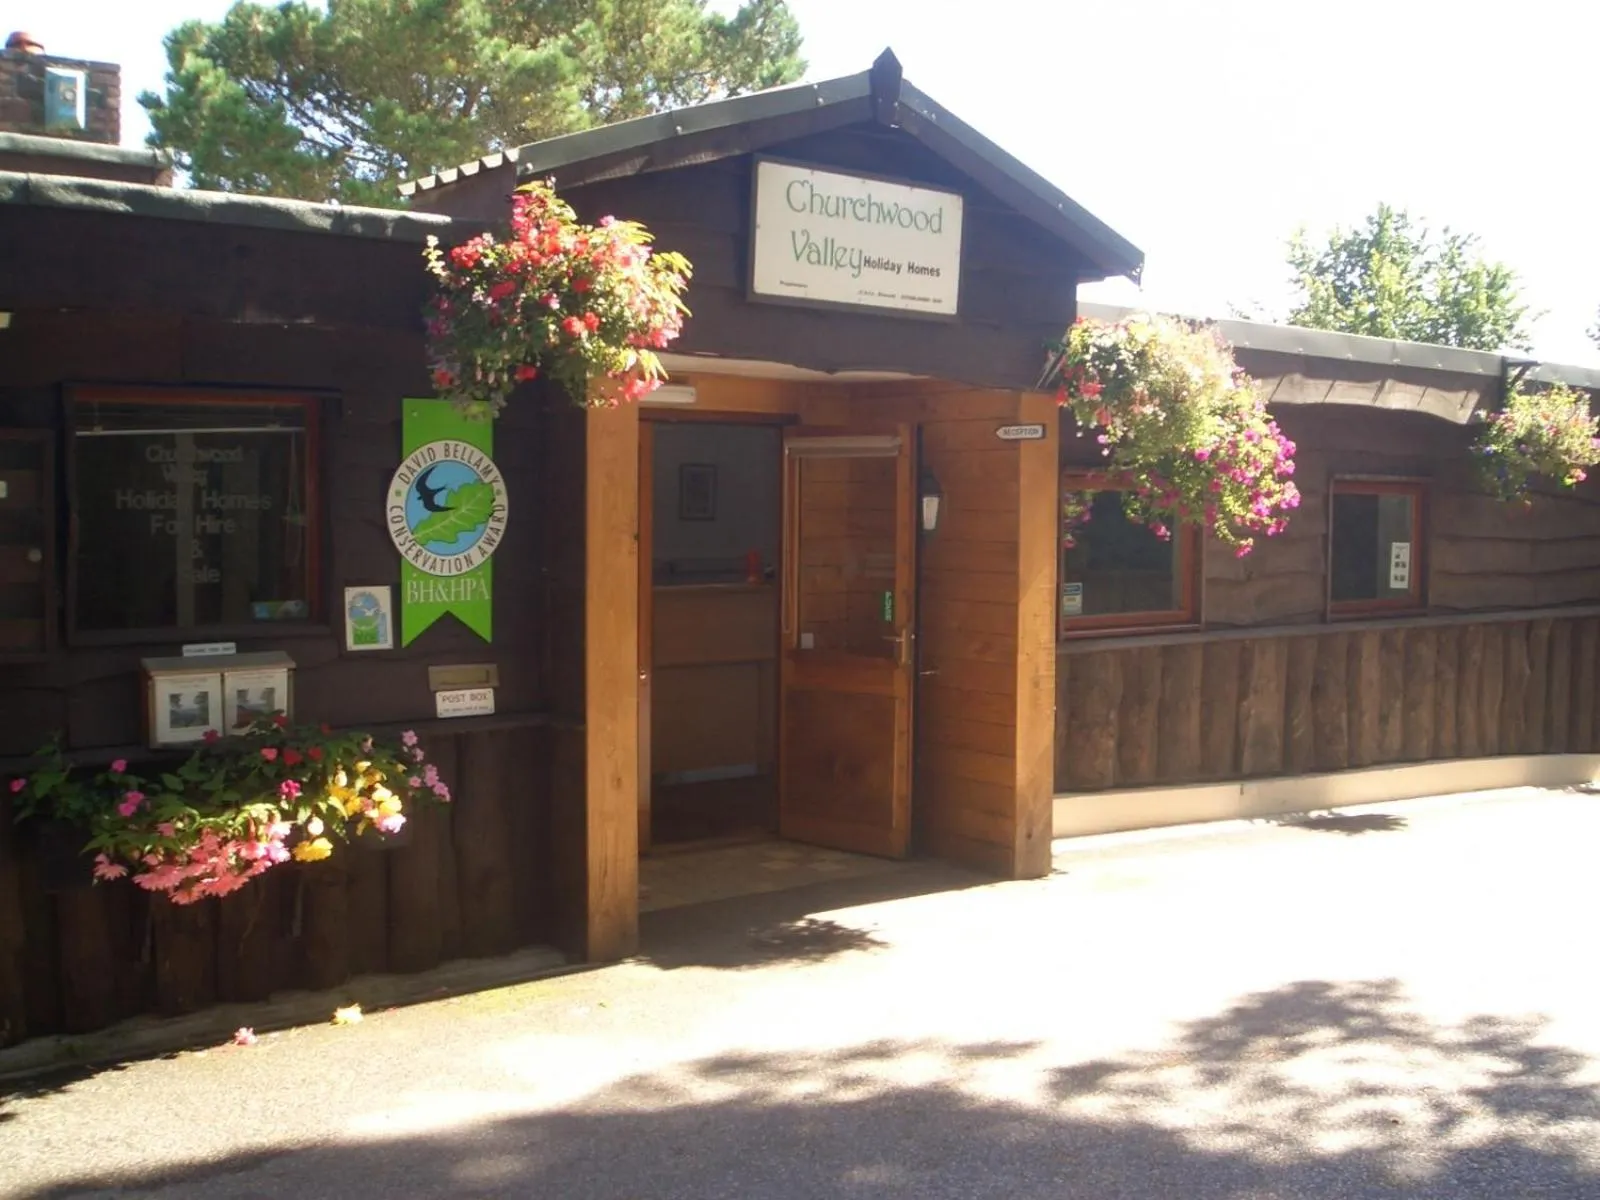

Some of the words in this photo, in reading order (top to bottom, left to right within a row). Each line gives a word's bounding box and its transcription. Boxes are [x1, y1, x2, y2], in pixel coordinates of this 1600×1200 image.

[786, 180, 943, 234] Churchwood
[791, 229, 864, 278] Valley
[863, 255, 902, 275] Holiday
[907, 261, 941, 277] Homes
[1003, 427, 1039, 437] RECEPTION
[145, 444, 244, 463] Chuhwood
[398, 447, 436, 485] DAVID
[443, 442, 500, 484] BELLAMY
[160, 464, 208, 486] Vaey
[115, 488, 192, 512] Holida
[201, 489, 273, 511] Homes
[195, 514, 237, 535] Hire
[389, 504, 474, 574] CONSERVATION
[477, 504, 506, 558] AWARD
[406, 577, 491, 604] BH&HPA
[442, 694, 465, 704] POST
[470, 692, 488, 702] BOX
